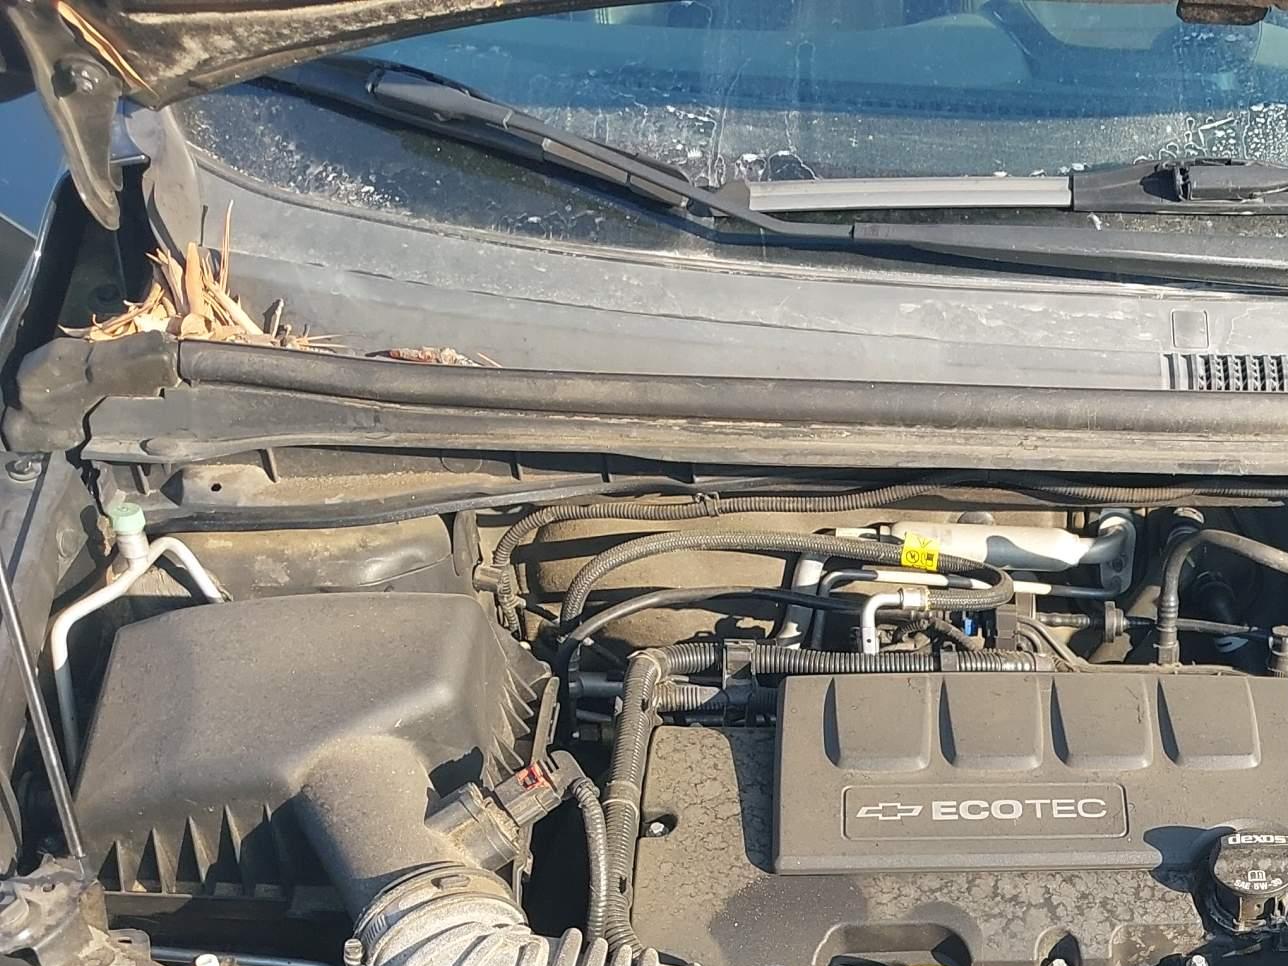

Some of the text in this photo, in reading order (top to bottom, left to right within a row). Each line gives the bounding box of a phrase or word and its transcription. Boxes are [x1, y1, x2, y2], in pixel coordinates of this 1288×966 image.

[931, 798, 1107, 820] ECOTEC
[1228, 833, 1288, 844] dexos
[1233, 879, 1250, 890] SAE
